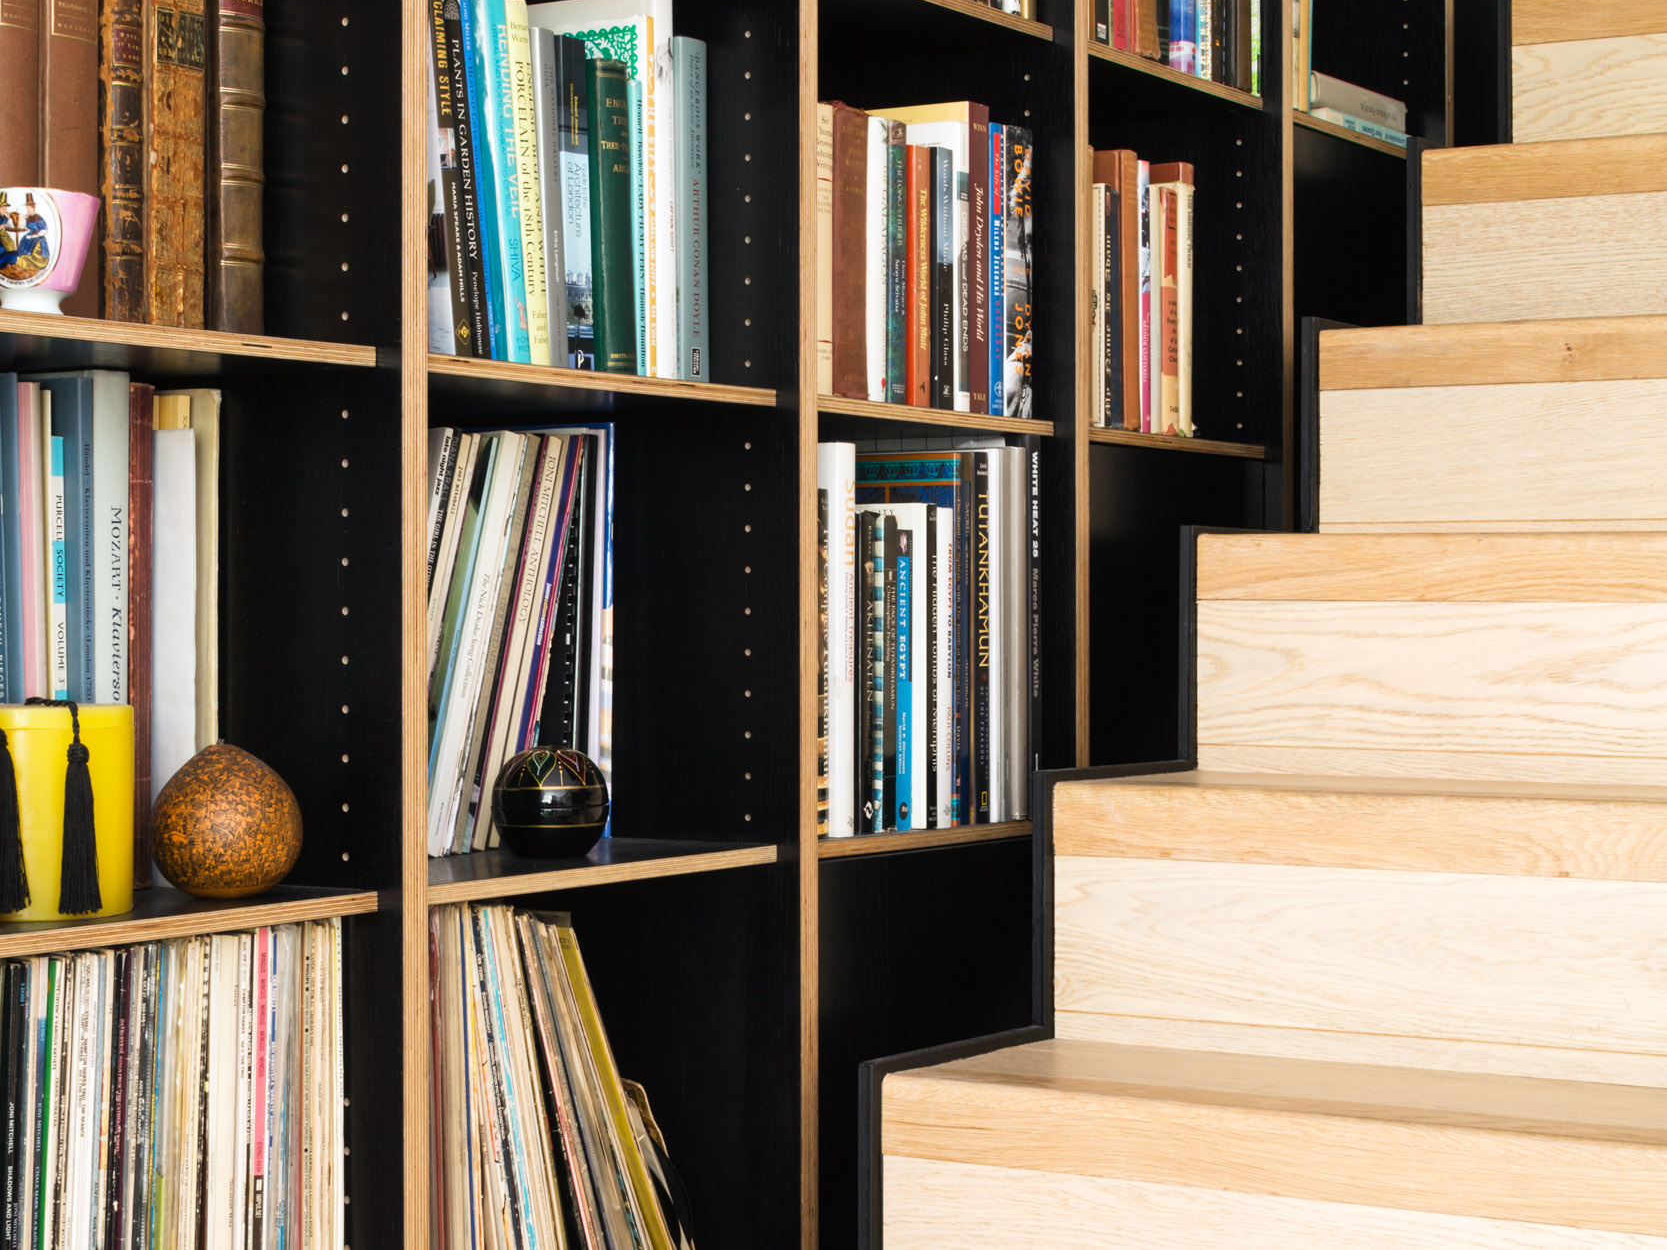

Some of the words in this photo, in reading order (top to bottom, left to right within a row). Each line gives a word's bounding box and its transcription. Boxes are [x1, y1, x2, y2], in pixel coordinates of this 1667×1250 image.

[452, 39, 464, 98] PLANTS
[497, 24, 515, 119] RENDING
[440, 76, 453, 117] STYLE
[457, 102, 466, 120] IN
[514, 61, 530, 158] PORCELAIN
[505, 122, 517, 167] THE
[973, 122, 988, 134] WINN
[458, 124, 472, 190] GARDEN
[521, 162, 532, 177] of
[567, 161, 575, 174] of
[942, 159, 950, 192] Words
[451, 182, 459, 210] MARIA
[508, 174, 521, 218] VEIL
[522, 182, 533, 203] the
[920, 188, 928, 208] The
[974, 183, 986, 213] John
[1014, 144, 1024, 217] BOWIE
[567, 176, 576, 224] London
[573, 161, 584, 238] Architecture
[692, 178, 701, 236] ARTHUR
[942, 195, 950, 237] Without
[453, 211, 461, 244] SPEAKE
[464, 195, 478, 261] HISTORY
[524, 207, 535, 237] 18th
[919, 209, 928, 258] Wilderness
[974, 215, 986, 260] Dryden
[456, 251, 464, 278] ADAM
[508, 238, 522, 282] SHIVA
[525, 241, 538, 296] Century
[693, 239, 701, 288] CONAN
[919, 261, 928, 290] World
[975, 260, 985, 282] and
[994, 255, 1002, 296] JESENSKÁ
[471, 271, 481, 310] Penelope
[919, 291, 928, 302] of
[976, 283, 985, 306] His
[1105, 292, 1112, 314] Is
[693, 293, 701, 338] DOYLE
[918, 302, 929, 325] John
[941, 303, 950, 336] Philip
[976, 306, 985, 343] World
[475, 312, 486, 355] Hobhouse
[919, 326, 928, 351] Muir
[1014, 302, 1024, 376] JONES
[942, 338, 950, 367] Glass
[973, 392, 987, 402] YALE
[443, 435, 451, 453] late
[447, 435, 459, 466] DIANA
[437, 454, 449, 477] night
[544, 455, 558, 483] JONI
[434, 478, 445, 497] jazz
[440, 469, 452, 505] KRALL
[55, 495, 63, 544] PURCELL
[533, 485, 553, 544] MITCHELL
[845, 478, 856, 566] Sudan
[111, 505, 123, 592] MOZART
[1032, 540, 1039, 559] 25
[56, 549, 65, 597] SOCIETY
[482, 573, 491, 589] The
[518, 549, 540, 624] ANTHOLOGY
[978, 489, 989, 668] TUTANKHAMUN
[477, 590, 487, 609] Nick
[899, 559, 907, 628] ANCIENT
[472, 611, 483, 637] Drake
[947, 613, 952, 627] TO
[57, 621, 65, 671] VOLUME
[467, 636, 478, 658] Song
[866, 599, 874, 702] AKHENATEN
[898, 631, 907, 680] EGYPT
[58, 676, 65, 684] 3
[459, 658, 475, 700] Collection
[931, 689, 938, 706] of
[929, 708, 938, 773] Memphis
